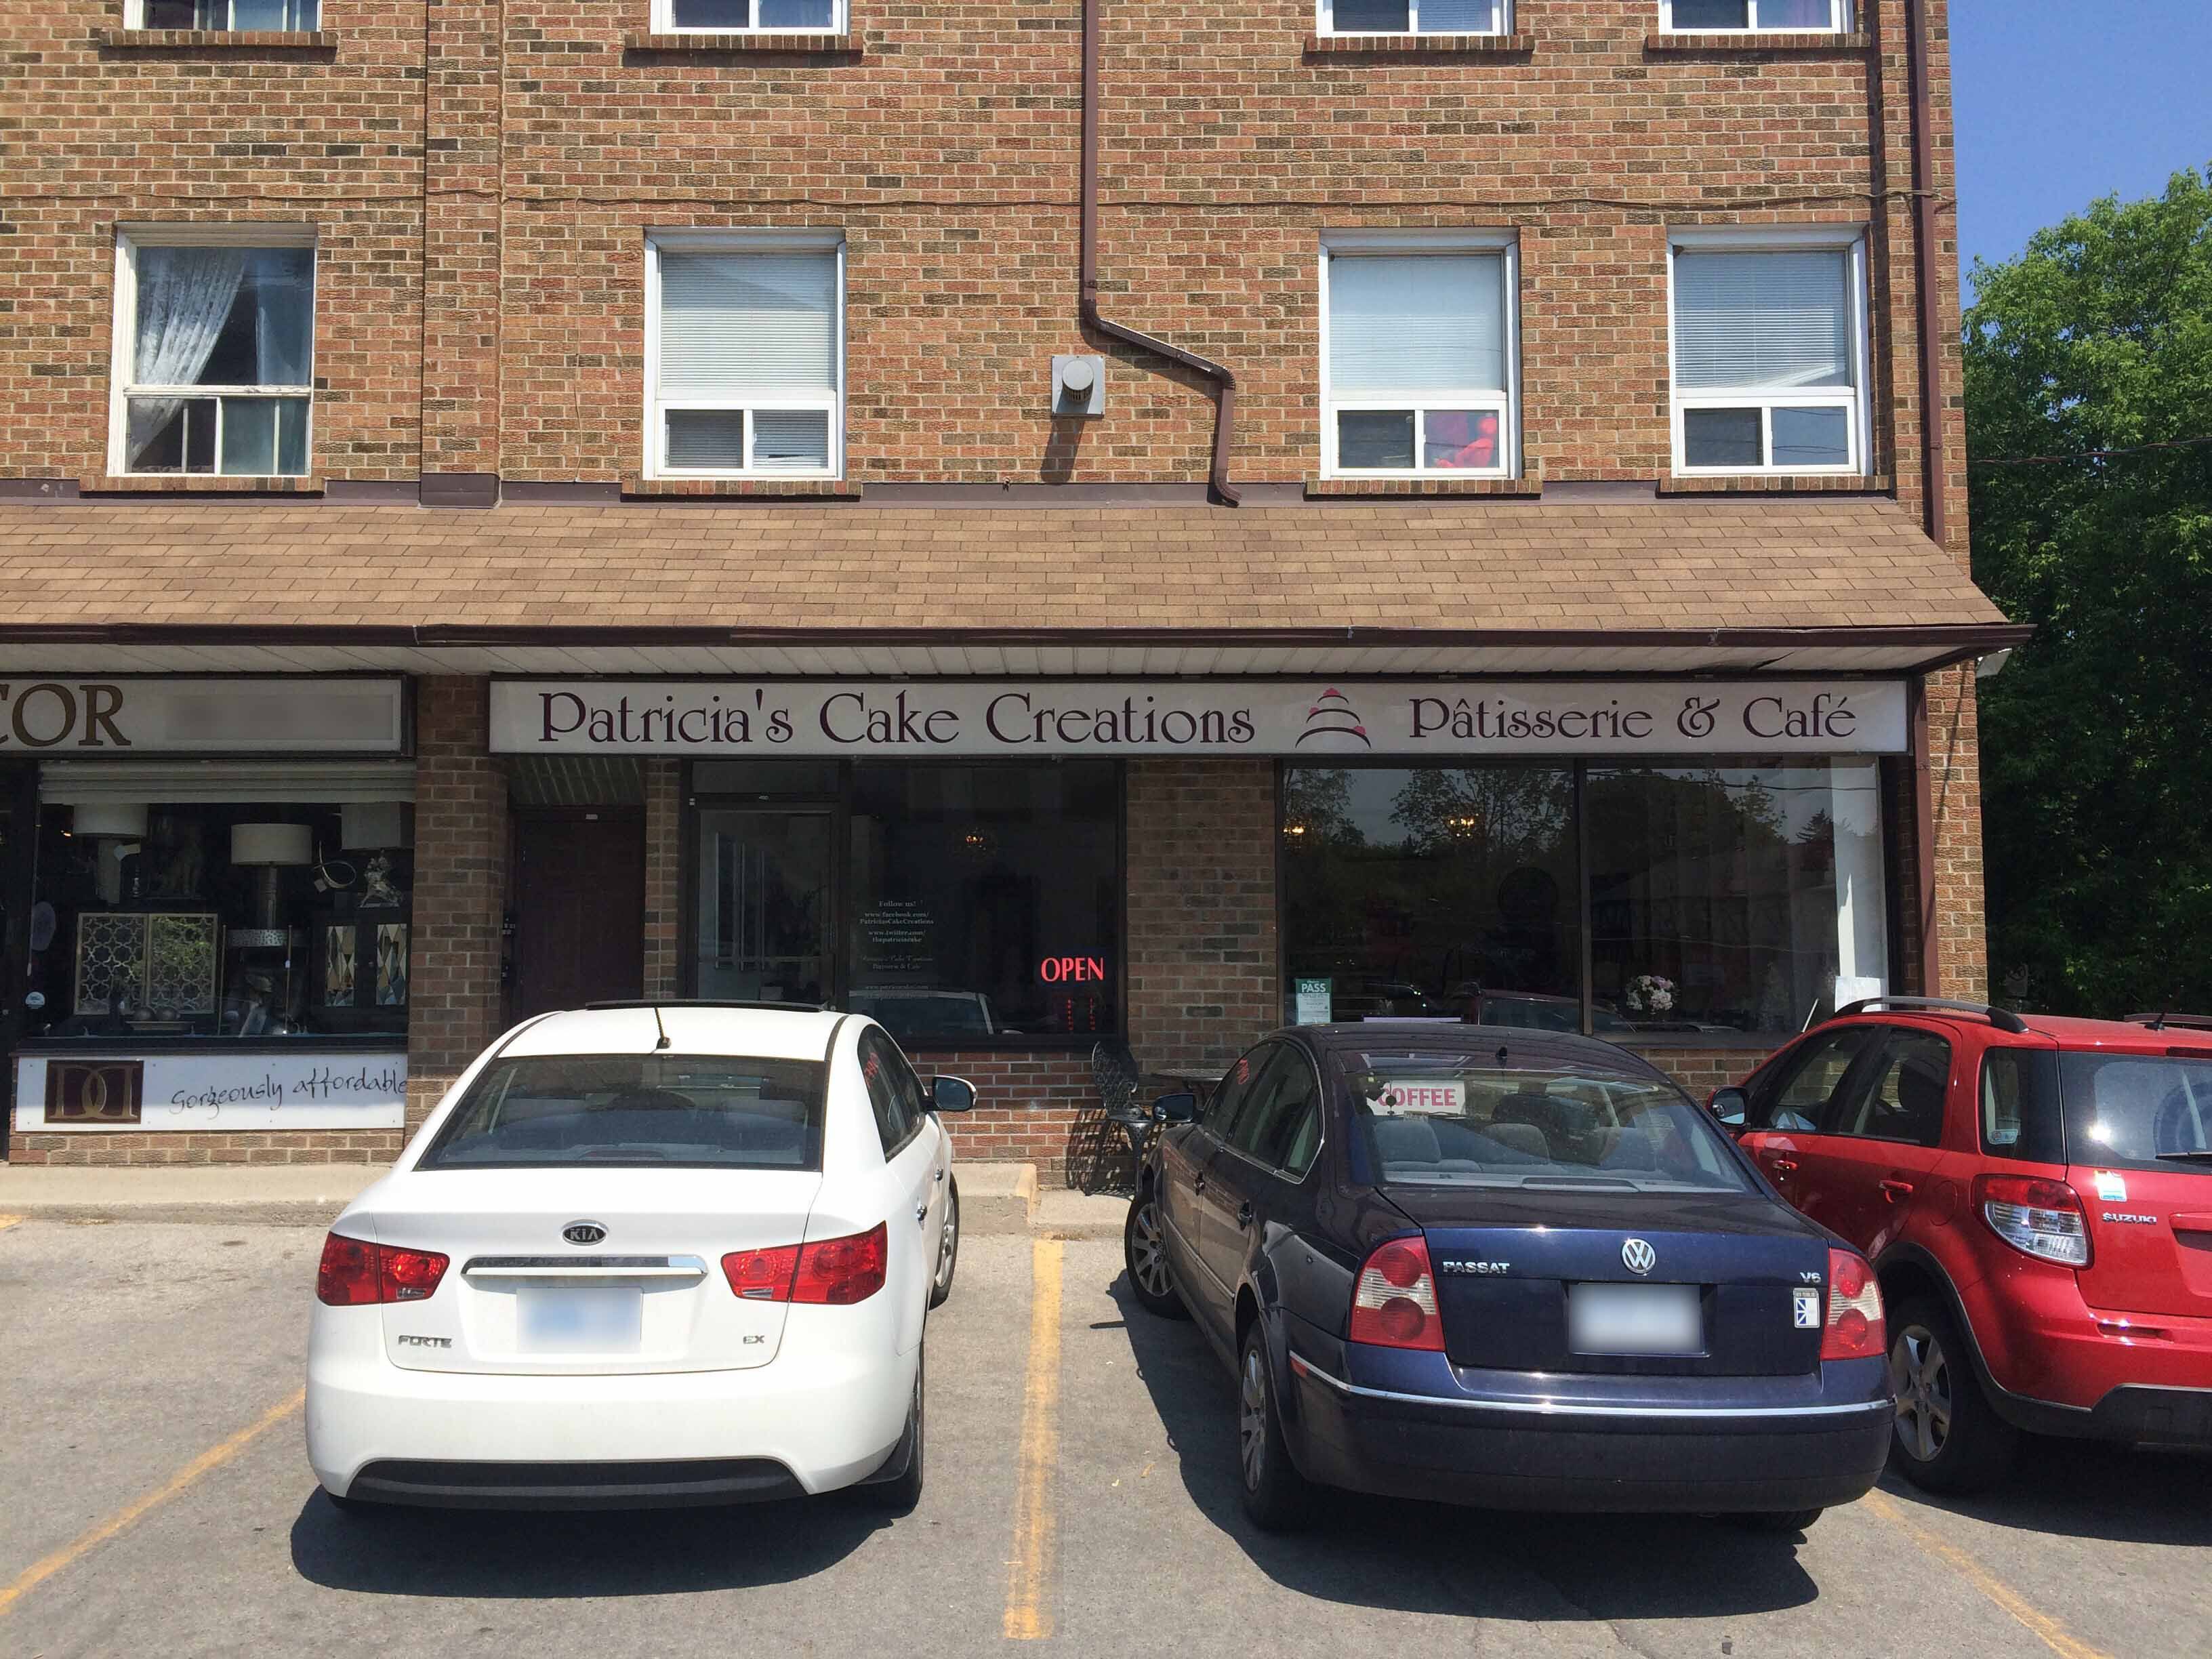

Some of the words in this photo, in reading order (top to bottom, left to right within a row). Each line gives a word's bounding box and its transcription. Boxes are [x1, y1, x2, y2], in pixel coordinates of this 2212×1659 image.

[0, 683, 132, 747] OR
[538, 688, 794, 743] Patricia's
[819, 689, 960, 743] Cake
[985, 692, 1256, 744] Creations
[1408, 697, 1653, 739] Pâtisserie
[1676, 697, 1721, 739] &
[1742, 693, 1858, 738] Café
[1041, 957, 1104, 982] OPEN
[1301, 983, 1326, 993] PASS
[169, 1073, 283, 1120] Gorgeously
[292, 1066, 407, 1099] affordable
[569, 1227, 598, 1241] KIA
[1442, 1261, 1511, 1274] PASSAT
[1799, 1271, 1822, 1284] V6
[398, 1334, 452, 1348] FORTE
[743, 1334, 764, 1344] EX
